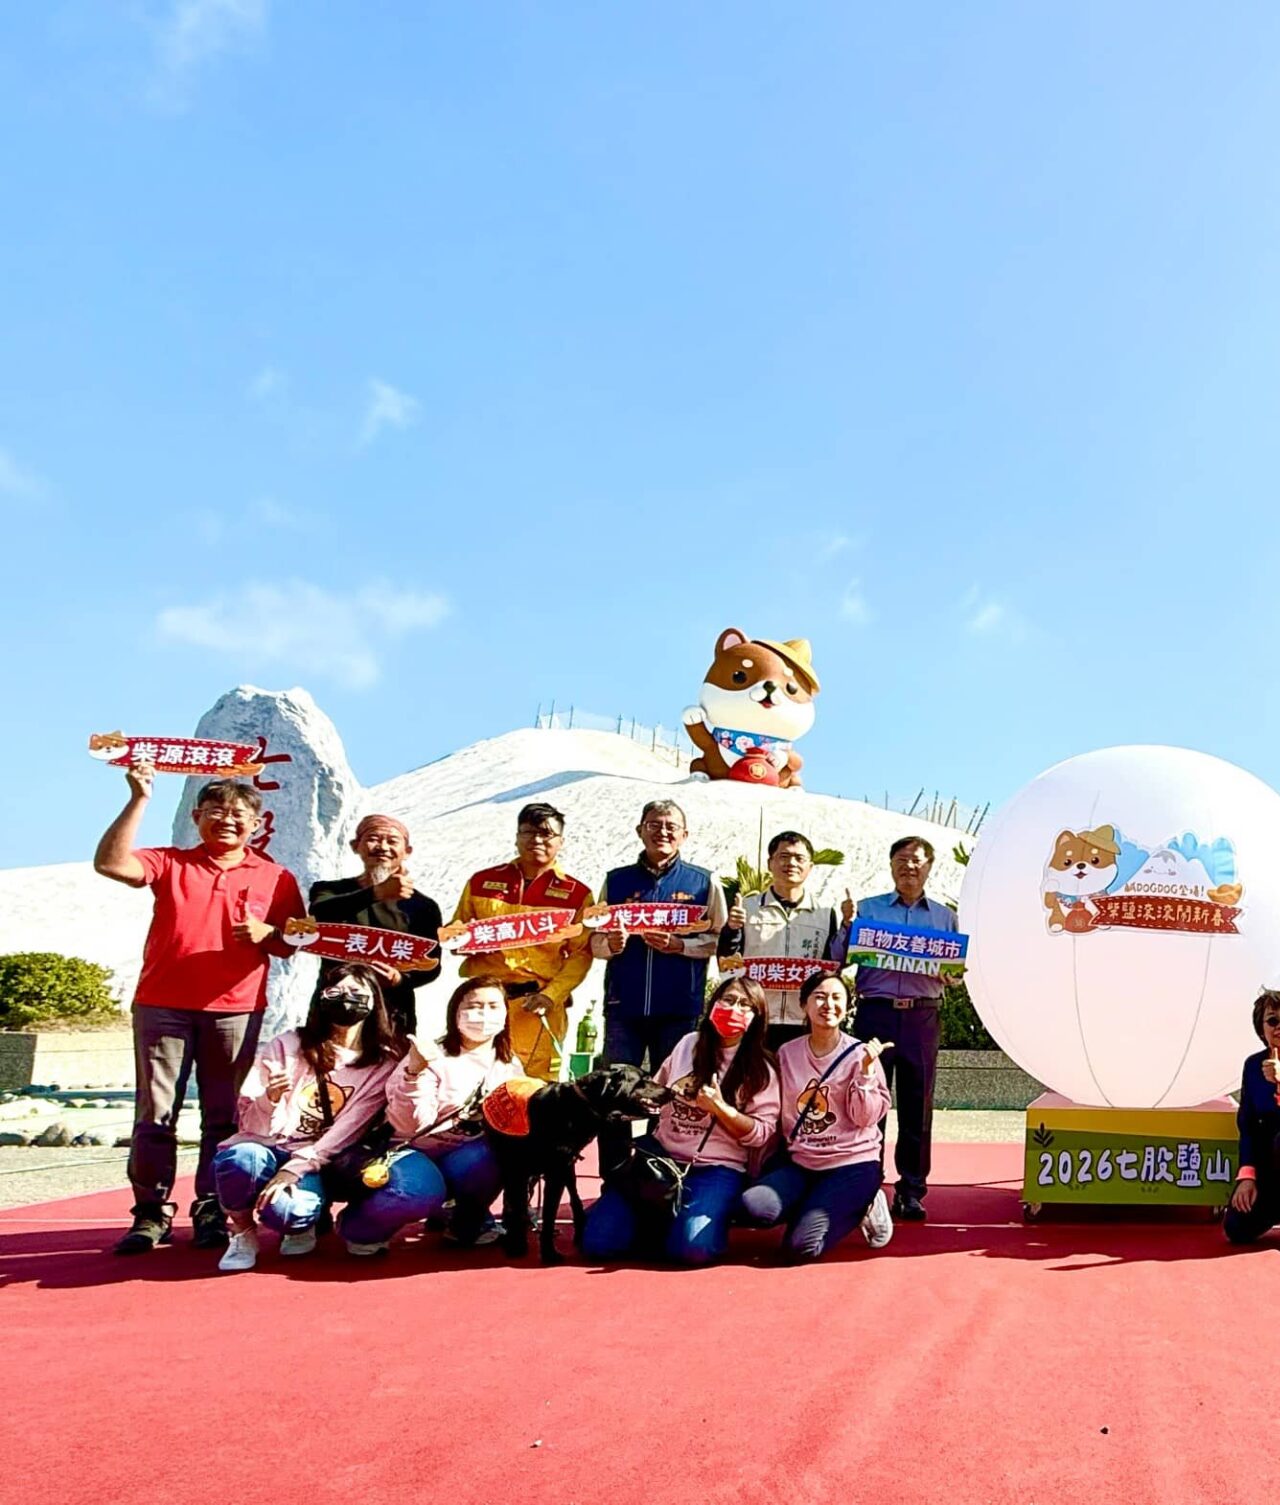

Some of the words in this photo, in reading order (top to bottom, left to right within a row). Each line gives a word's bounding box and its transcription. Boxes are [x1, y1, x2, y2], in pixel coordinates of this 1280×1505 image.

[131, 742, 236, 766] 柴源滾滾
[473, 915, 558, 945] 柴高八斗
[613, 908, 689, 926] 柴大氣粗
[322, 932, 414, 961] 一表人柴
[857, 927, 963, 959] 寵物友善城市
[876, 953, 942, 976] TAINAN
[1038, 1143, 1231, 1187] 2026七股鹽山
